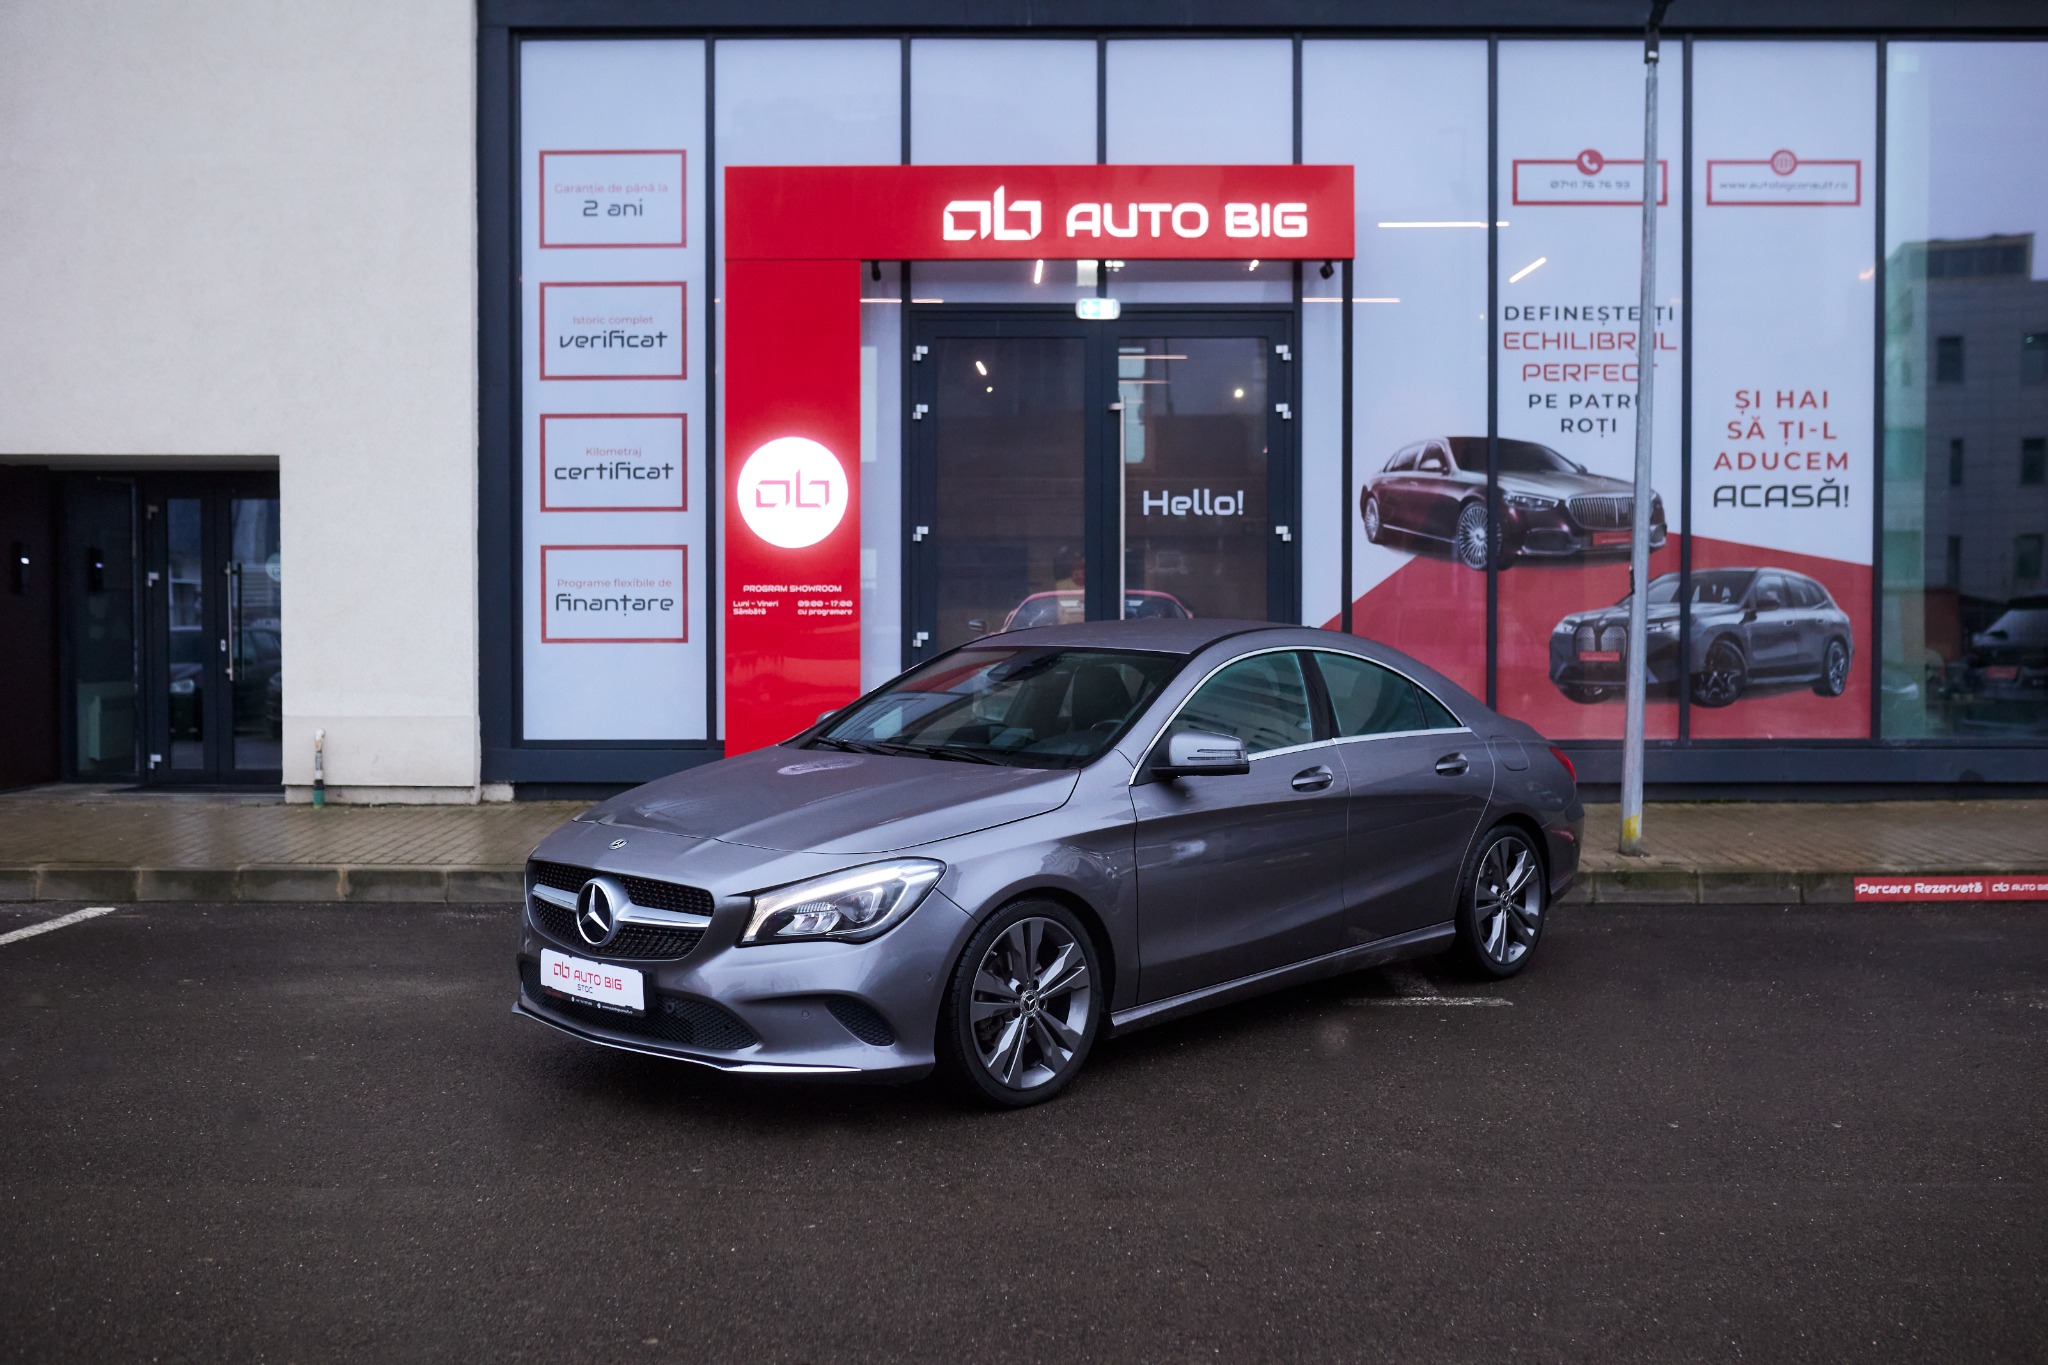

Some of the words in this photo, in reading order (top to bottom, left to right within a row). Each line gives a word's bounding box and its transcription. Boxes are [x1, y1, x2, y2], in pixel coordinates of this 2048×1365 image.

[607, 183, 623, 193] de
[658, 183, 669, 193] la
[583, 200, 599, 217] 2
[607, 199, 643, 217] ani
[1066, 203, 1209, 238] AUTO
[1225, 203, 1308, 238] BIG
[573, 315, 605, 325] Istoric
[608, 315, 654, 327] complet
[560, 330, 668, 348] verificat
[1522, 363, 1658, 382] PERFEC
[1528, 394, 1557, 408] PE
[1569, 394, 1638, 408] PATR
[1735, 390, 1760, 415] ȘI
[1776, 390, 1828, 409] HAI
[1560, 418, 1616, 438] ROȚI
[1727, 416, 1765, 440] SĂ
[1778, 421, 1837, 446] ȚI-L
[586, 447, 642, 457] Kilometraj
[1713, 452, 1848, 471] ADUCEM
[554, 462, 674, 480] certificat
[1713, 477, 1849, 508] ACASĂ!
[1143, 488, 1244, 516] Hello!
[557, 579, 611, 589] Programe
[613, 578, 655, 588] flexibile
[658, 578, 672, 588] de
[555, 593, 674, 616] finanțare
[1857, 883, 1911, 894] Parcare
[1914, 881, 1983, 894] Rezervată
[2011, 883, 2037, 892] AUTO
[573, 969, 601, 986] AUTO
[604, 976, 622, 990] BIG
[577, 983, 593, 994] STOC
